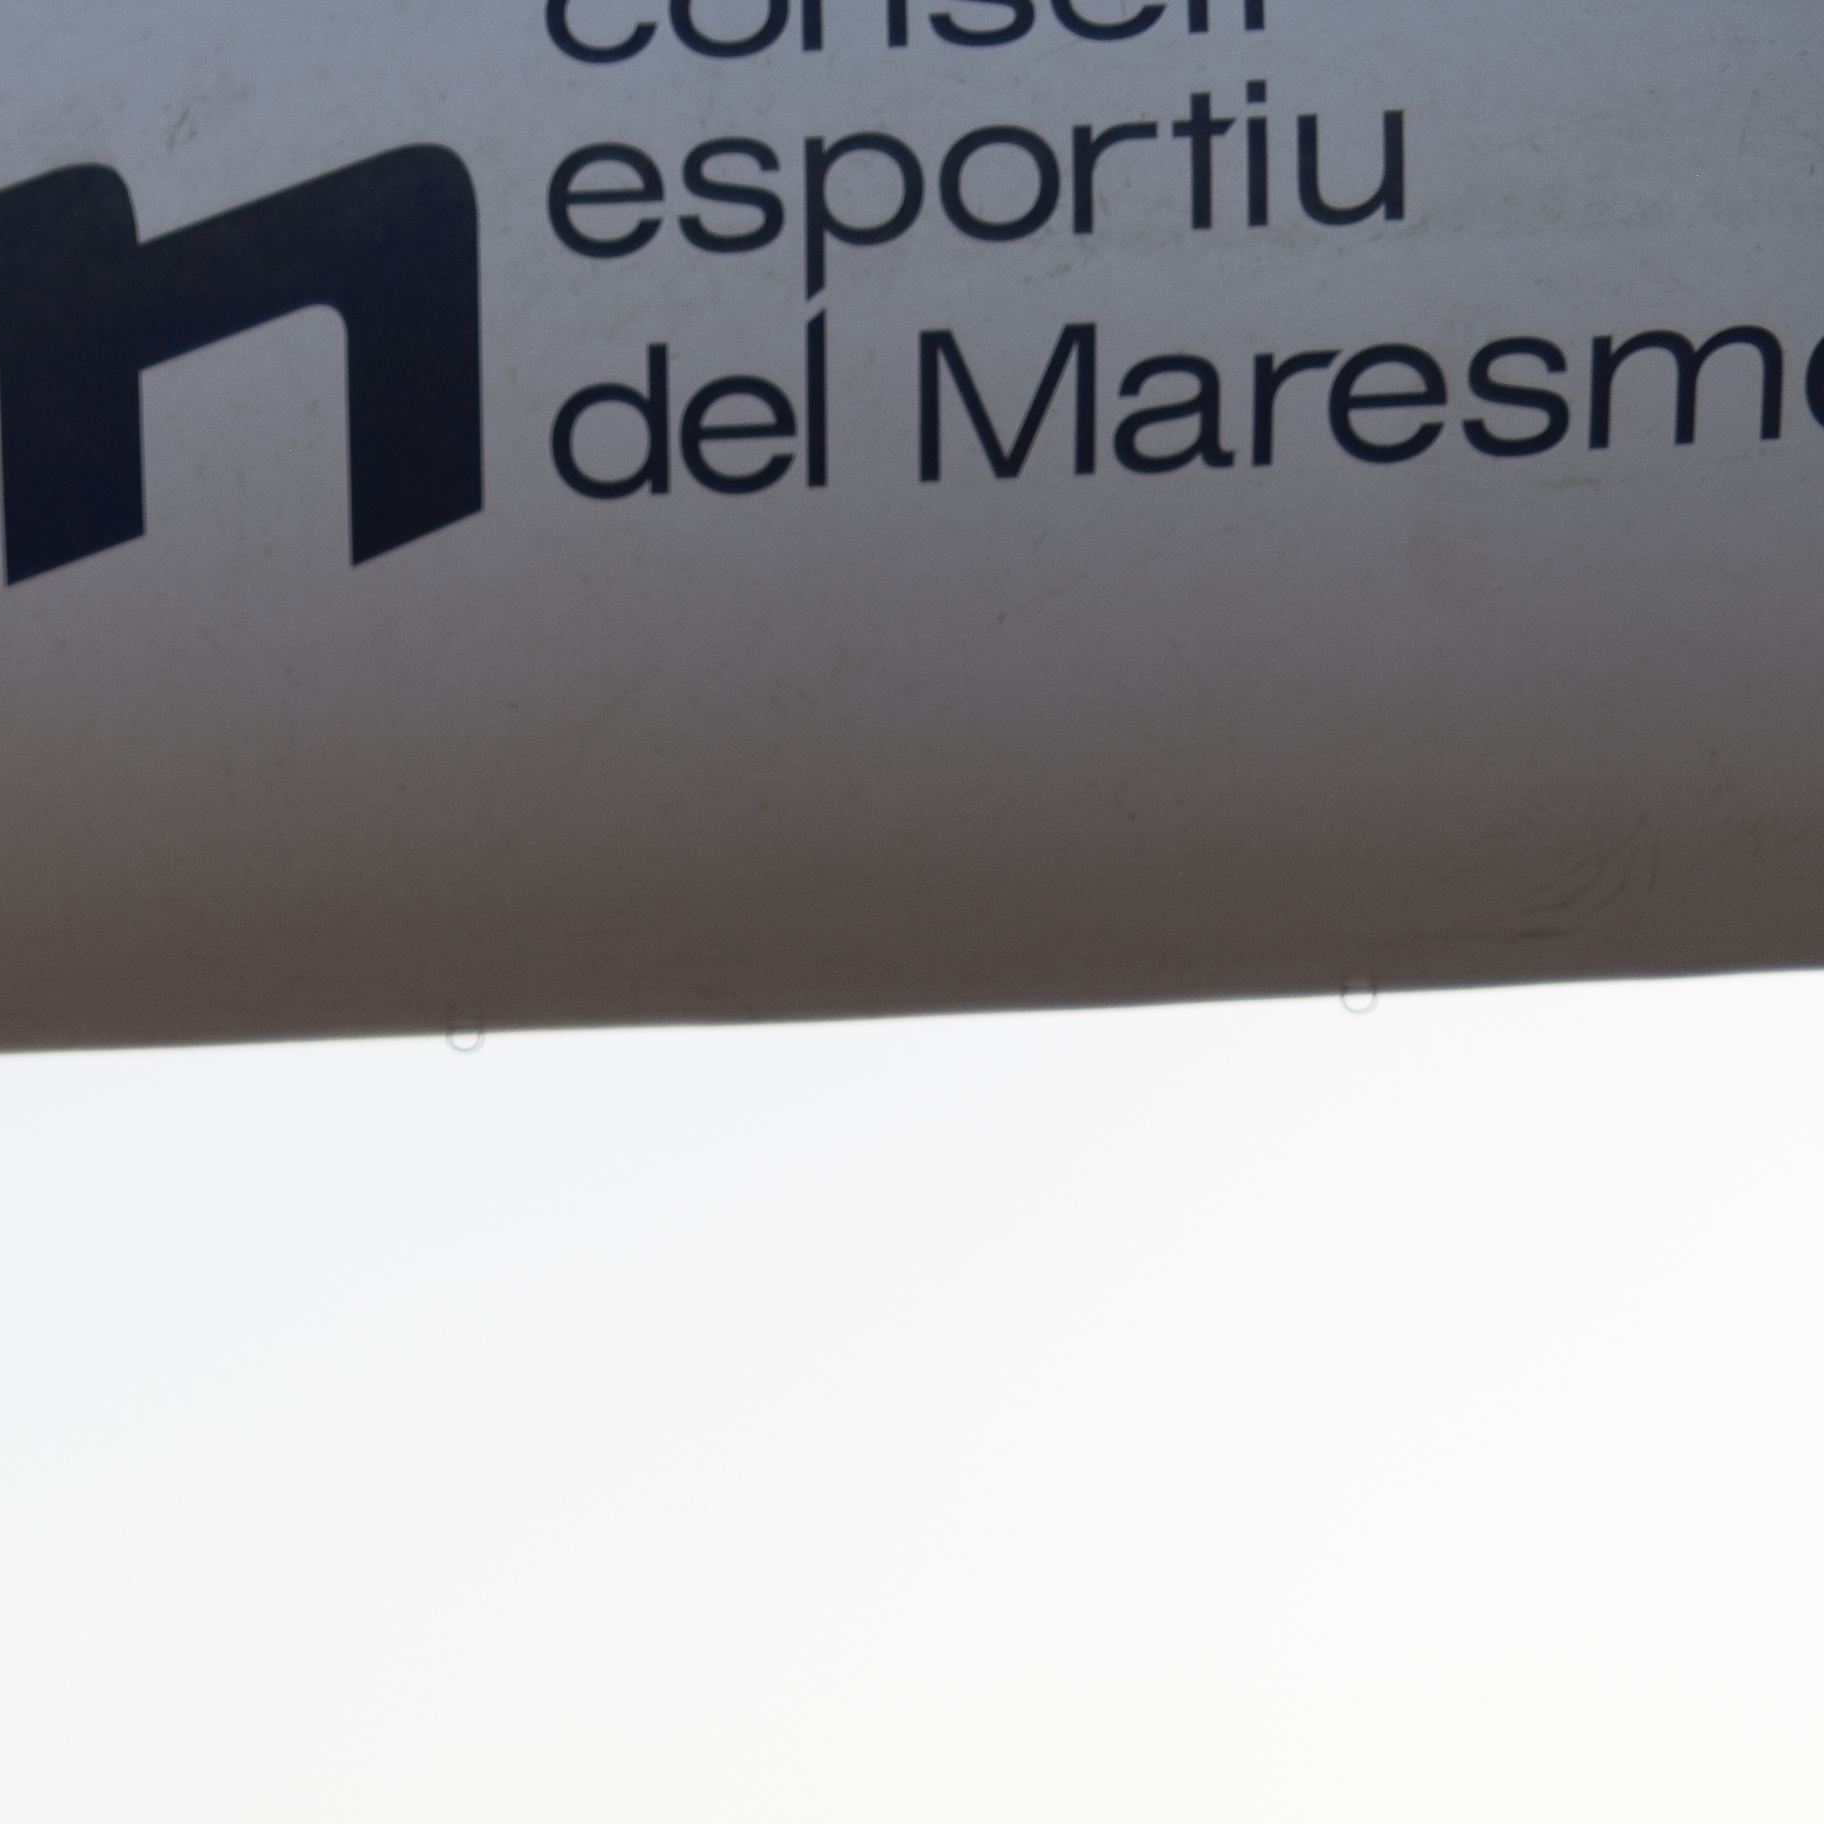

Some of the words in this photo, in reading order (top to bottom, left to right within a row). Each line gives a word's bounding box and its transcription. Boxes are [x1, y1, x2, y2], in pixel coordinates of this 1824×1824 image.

[548, 80, 1407, 301] esportiu
[551, 308, 830, 503] del
[919, 324, 1824, 484] Maresm
